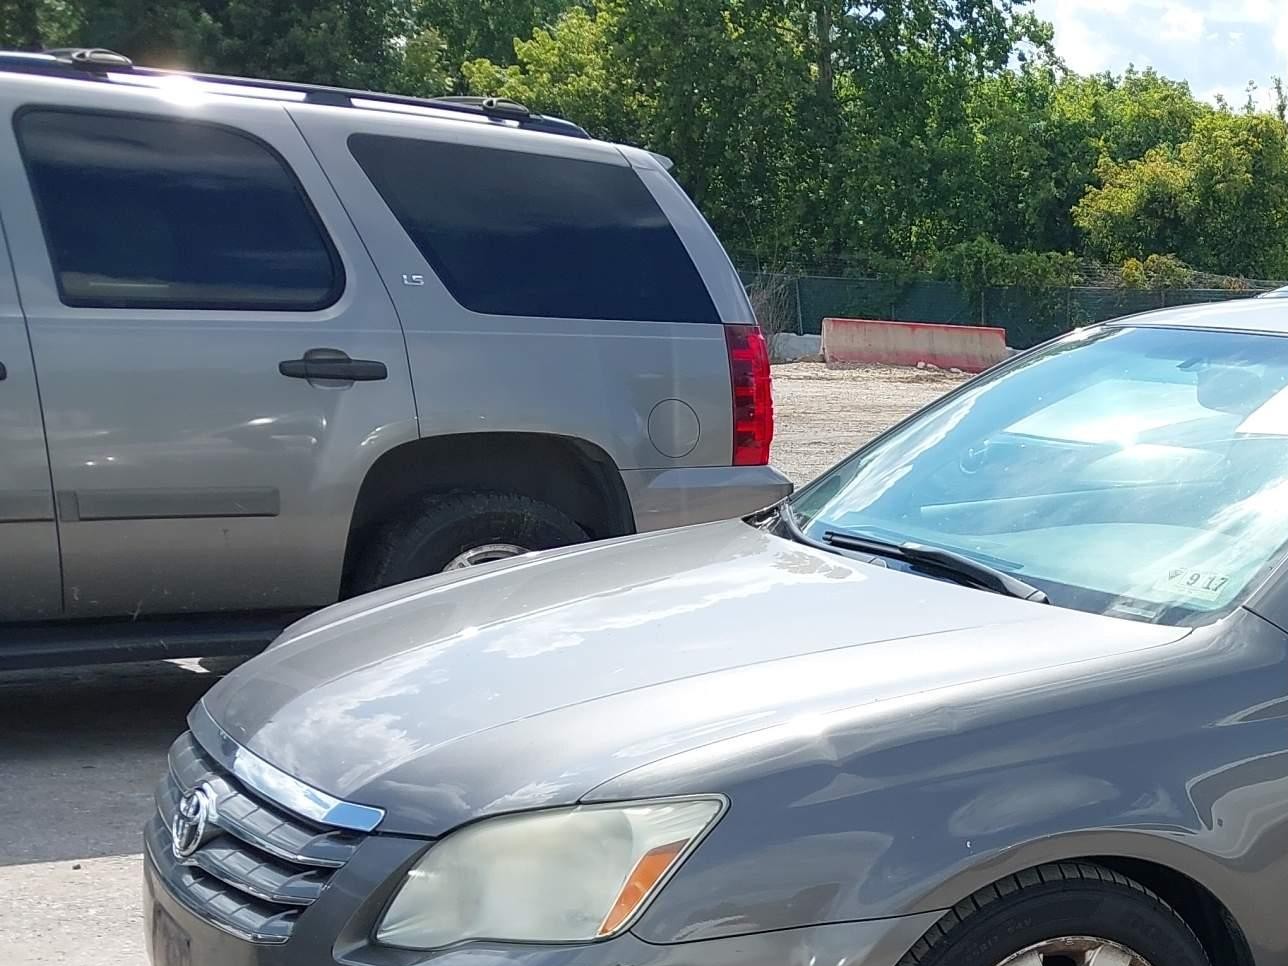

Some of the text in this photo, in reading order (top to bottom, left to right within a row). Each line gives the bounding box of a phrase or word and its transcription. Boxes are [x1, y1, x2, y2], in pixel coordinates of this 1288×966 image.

[402, 274, 425, 286] LS
[1186, 572, 1229, 591] 9 17
